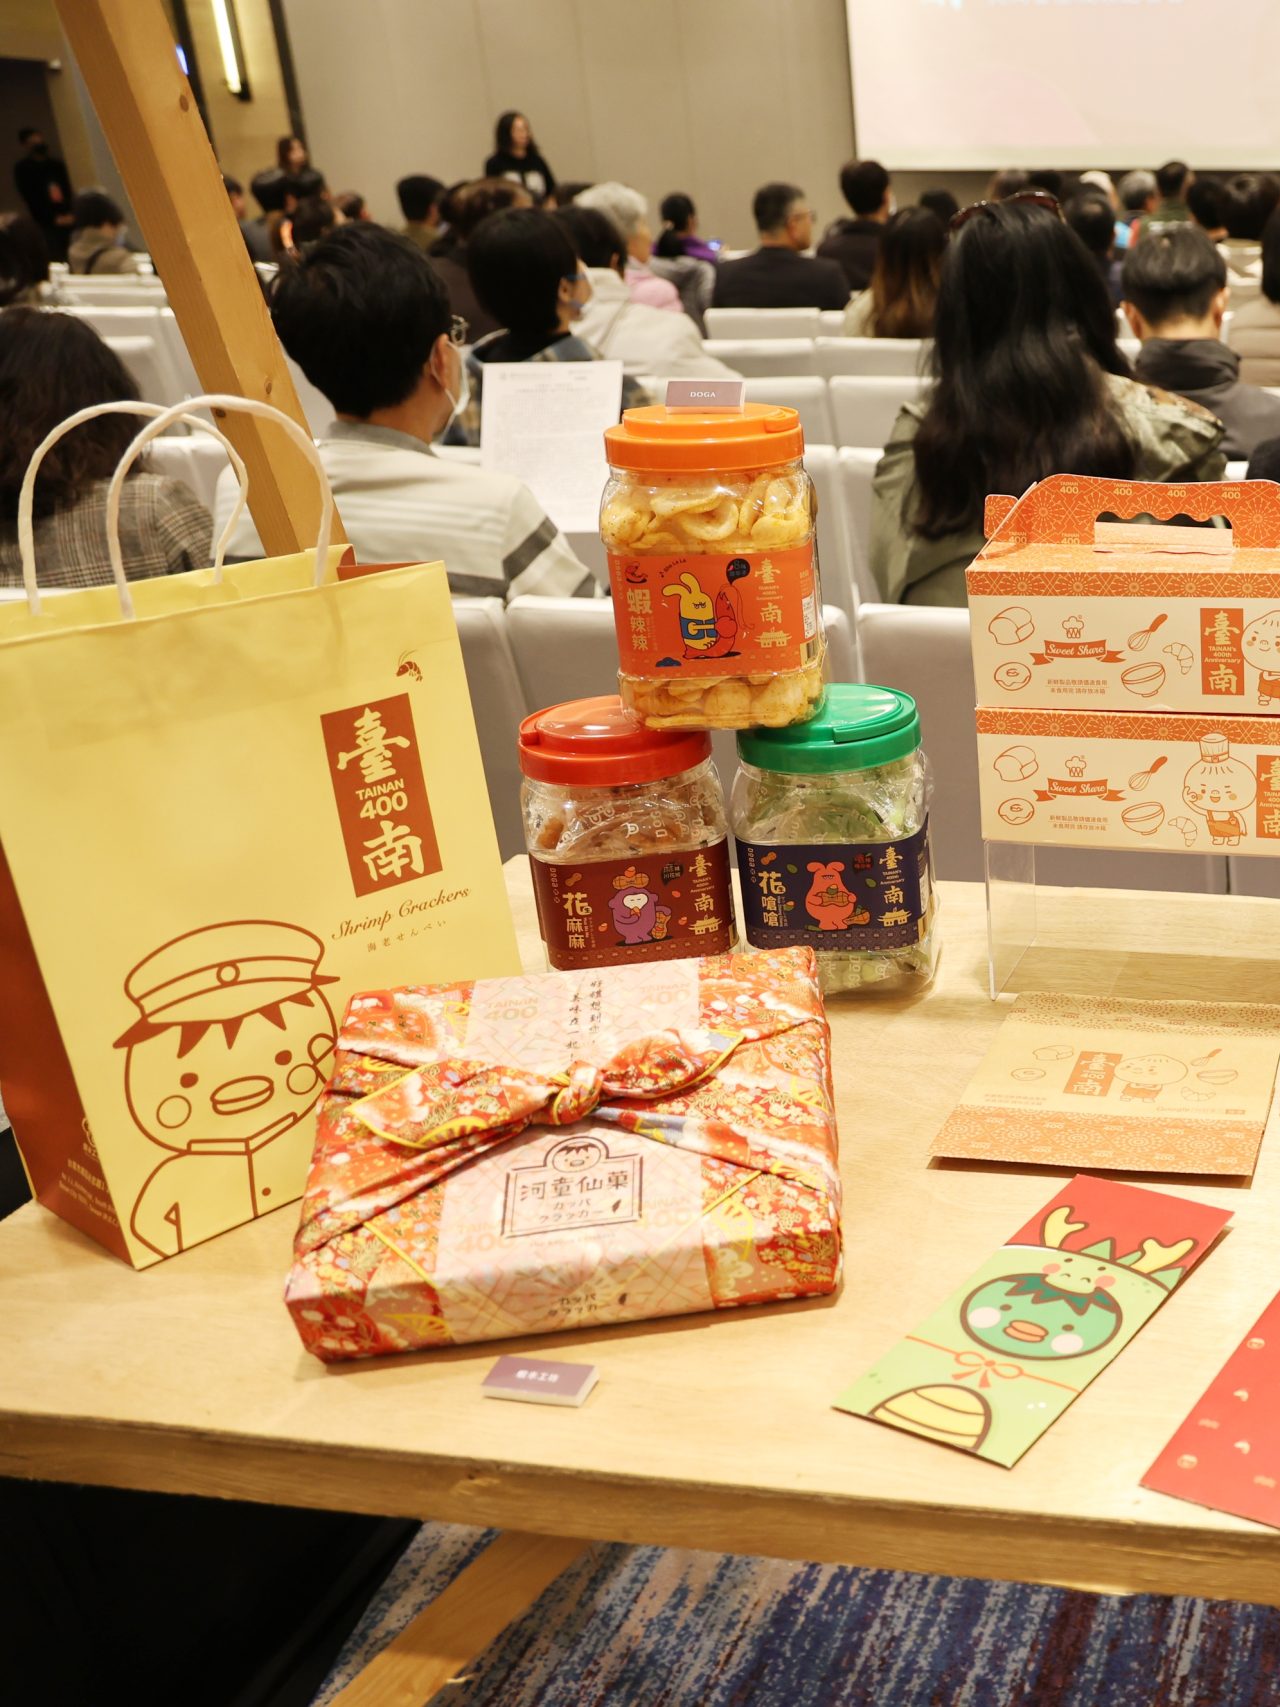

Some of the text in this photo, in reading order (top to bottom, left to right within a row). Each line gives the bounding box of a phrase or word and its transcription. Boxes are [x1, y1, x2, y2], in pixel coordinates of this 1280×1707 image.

[1060, 486, 1079, 494] 400
[1113, 488, 1133, 496] 400
[1166, 490, 1186, 498] 400
[1221, 491, 1241, 500] 400
[1008, 536, 1027, 544] 400
[754, 558, 780, 584] 臺
[760, 602, 782, 624] 南
[1204, 610, 1240, 645] 臺
[1047, 644, 1104, 656] Sweet Share
[1208, 664, 1238, 694] 南
[337, 706, 410, 784] 臺
[356, 778, 405, 800] TAINAN
[1050, 782, 1106, 794] Sweet Share
[359, 792, 408, 821] 400
[362, 820, 424, 882] 南
[879, 846, 904, 870] 臺
[688, 854, 712, 878] 臺
[694, 892, 714, 912] 南
[884, 886, 904, 904] 南
[331, 887, 470, 940] Shrimp Crackers
[1072, 1078, 1103, 1096] 南
[1080, 1072, 1105, 1080] 400
[520, 1170, 629, 1201] 河童仙菓
